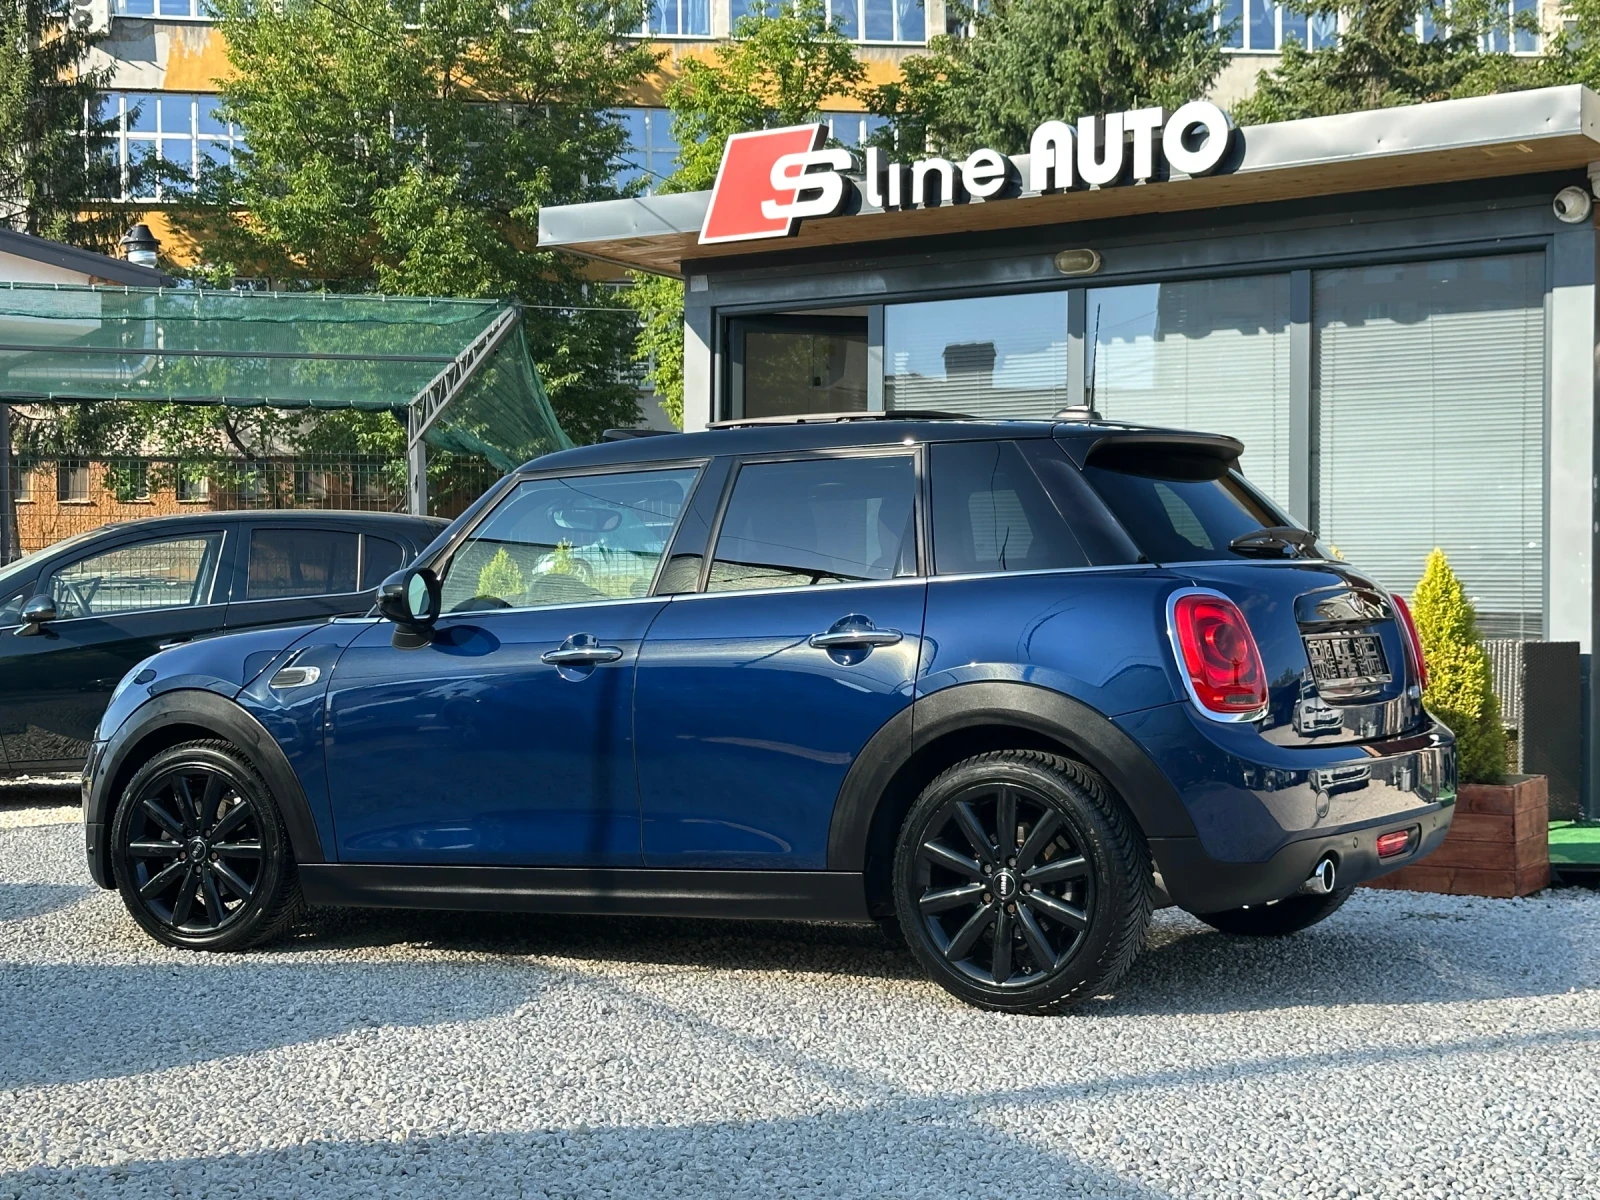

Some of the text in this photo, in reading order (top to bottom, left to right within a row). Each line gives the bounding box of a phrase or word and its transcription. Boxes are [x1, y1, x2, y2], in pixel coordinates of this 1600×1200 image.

[760, 101, 1230, 220] S line AUTO
